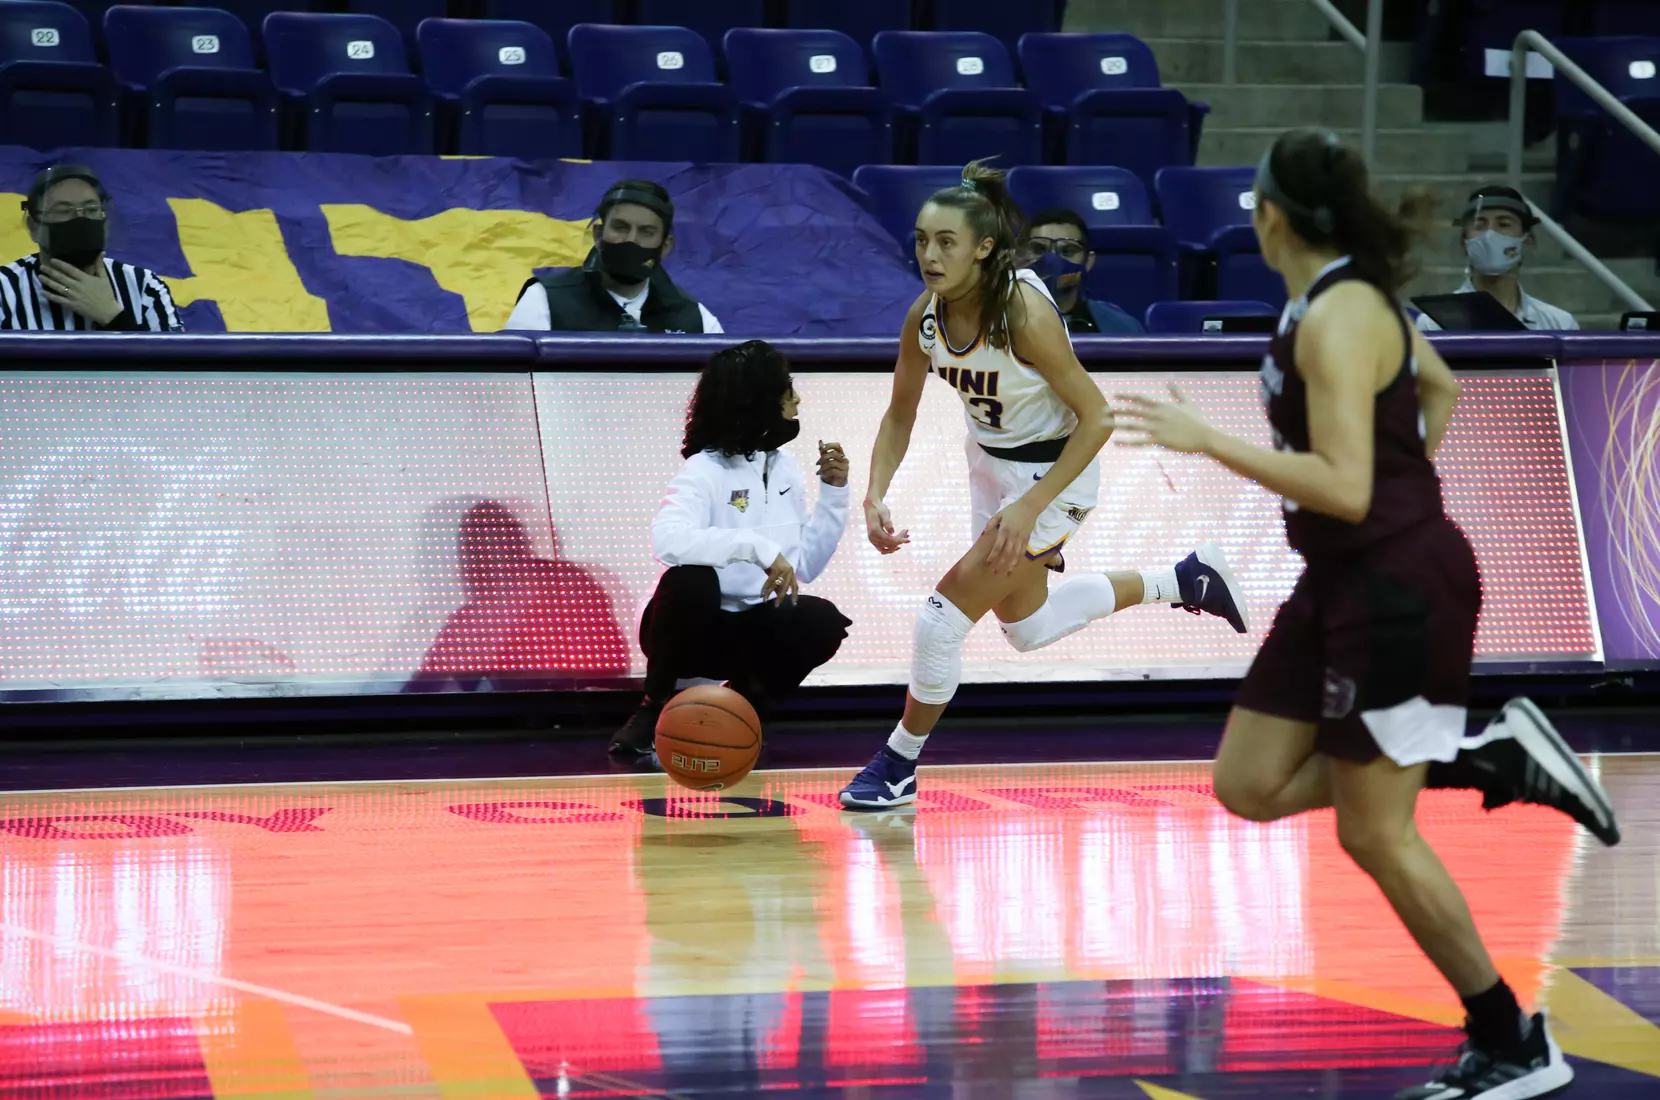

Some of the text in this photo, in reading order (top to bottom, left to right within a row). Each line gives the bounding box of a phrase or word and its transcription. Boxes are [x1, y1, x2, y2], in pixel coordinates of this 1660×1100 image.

[36, 31, 54, 43] 22
[197, 38, 215, 50] 23
[352, 44, 369, 55] 24
[504, 49, 521, 61] 25
[661, 54, 678, 66] 26
[815, 57, 831, 69] 27
[938, 365, 1000, 398] UNI
